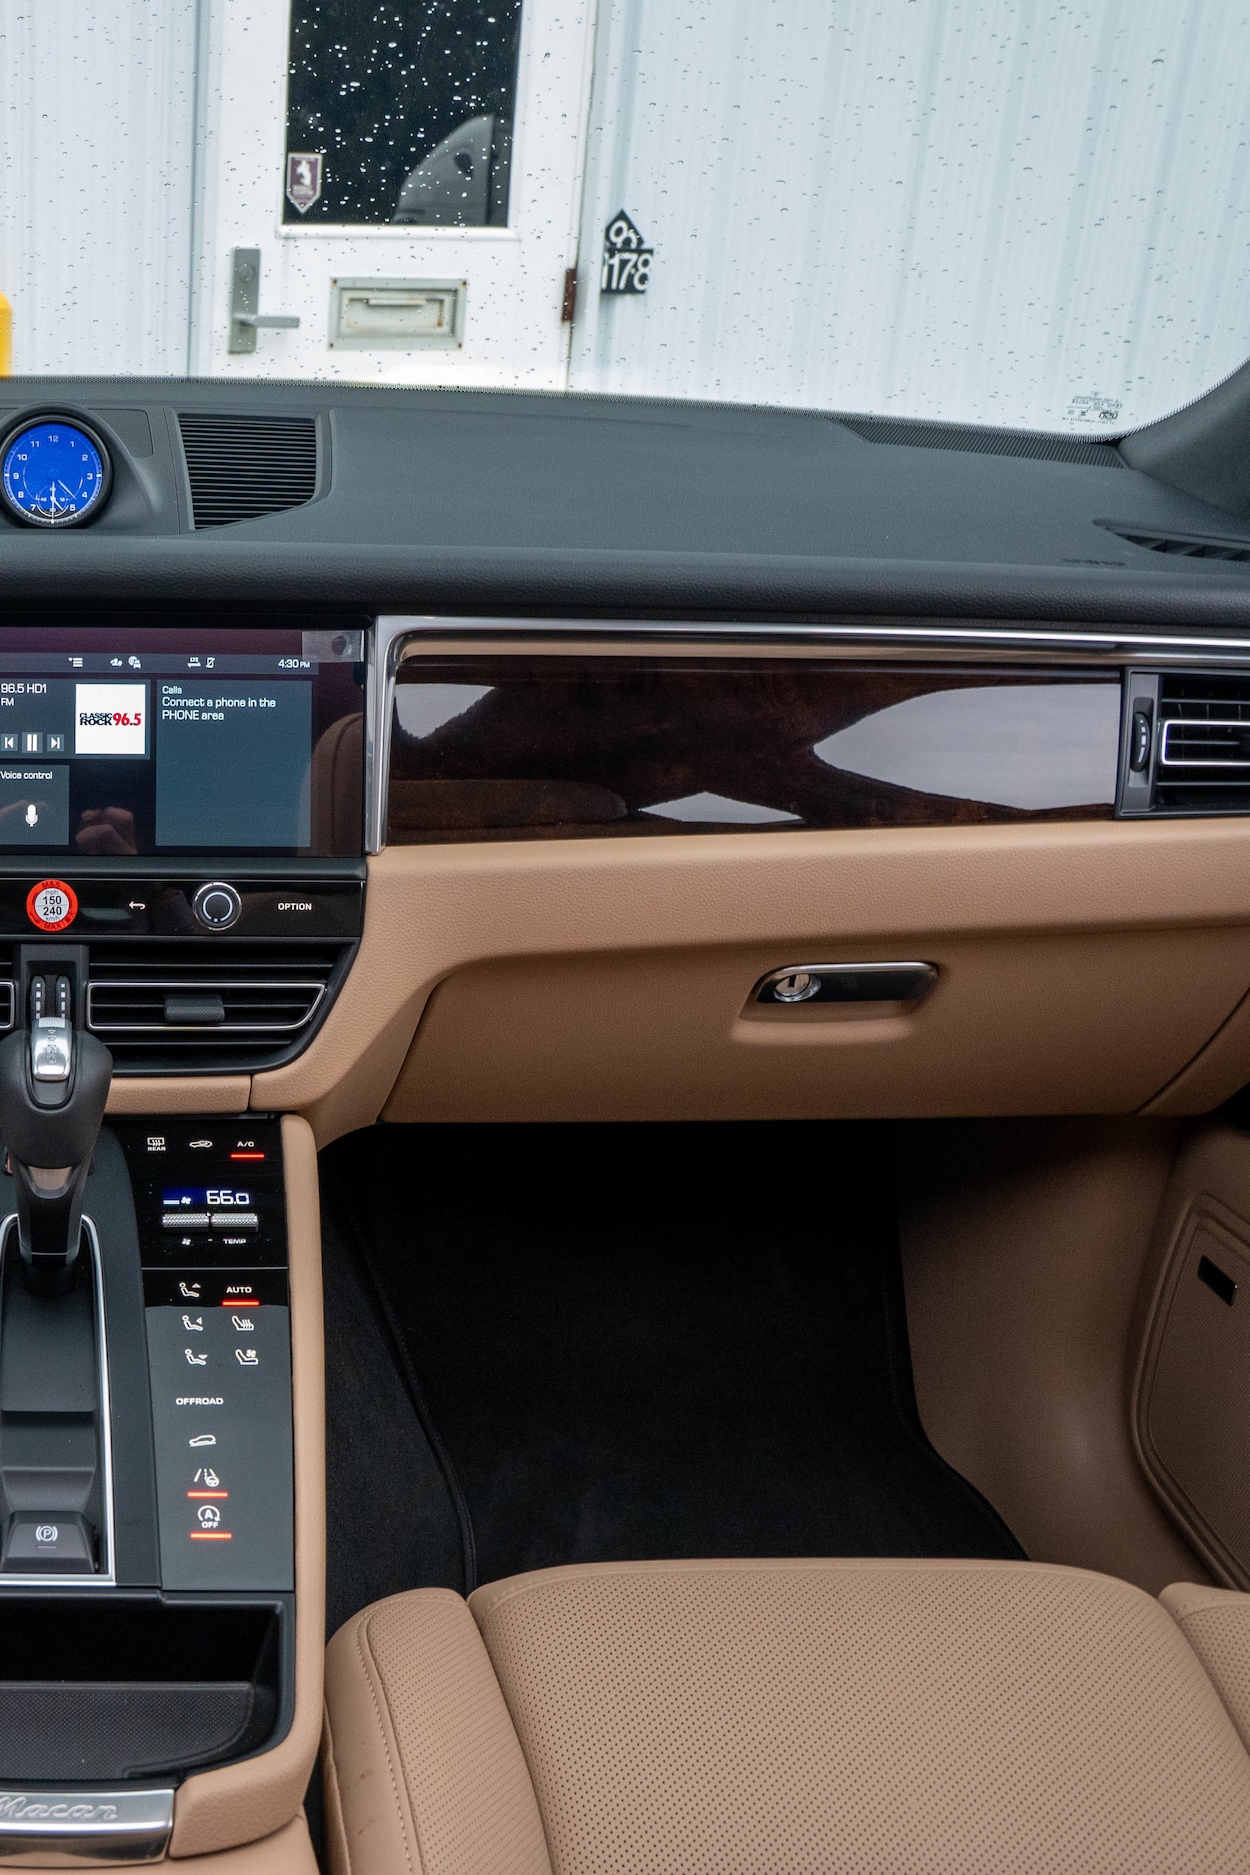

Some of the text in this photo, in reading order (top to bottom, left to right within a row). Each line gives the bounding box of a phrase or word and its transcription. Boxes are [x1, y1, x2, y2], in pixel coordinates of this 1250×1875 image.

[278, 659, 299, 669] 4:30
[0, 683, 47, 694] 96.5 HD1
[161, 686, 183, 695] Calls
[0, 698, 15, 706] FM
[161, 697, 276, 709] Connect a phone in the
[79, 712, 142, 727] ROCK 96.5
[161, 710, 224, 720] PHONE area
[0, 771, 53, 780] Voice control
[42, 895, 62, 905] 150
[43, 906, 62, 916] 240
[277, 902, 312, 911] OPTION
[206, 1190, 250, 1205] 66.0
[175, 1397, 224, 1406] OFFROAD
